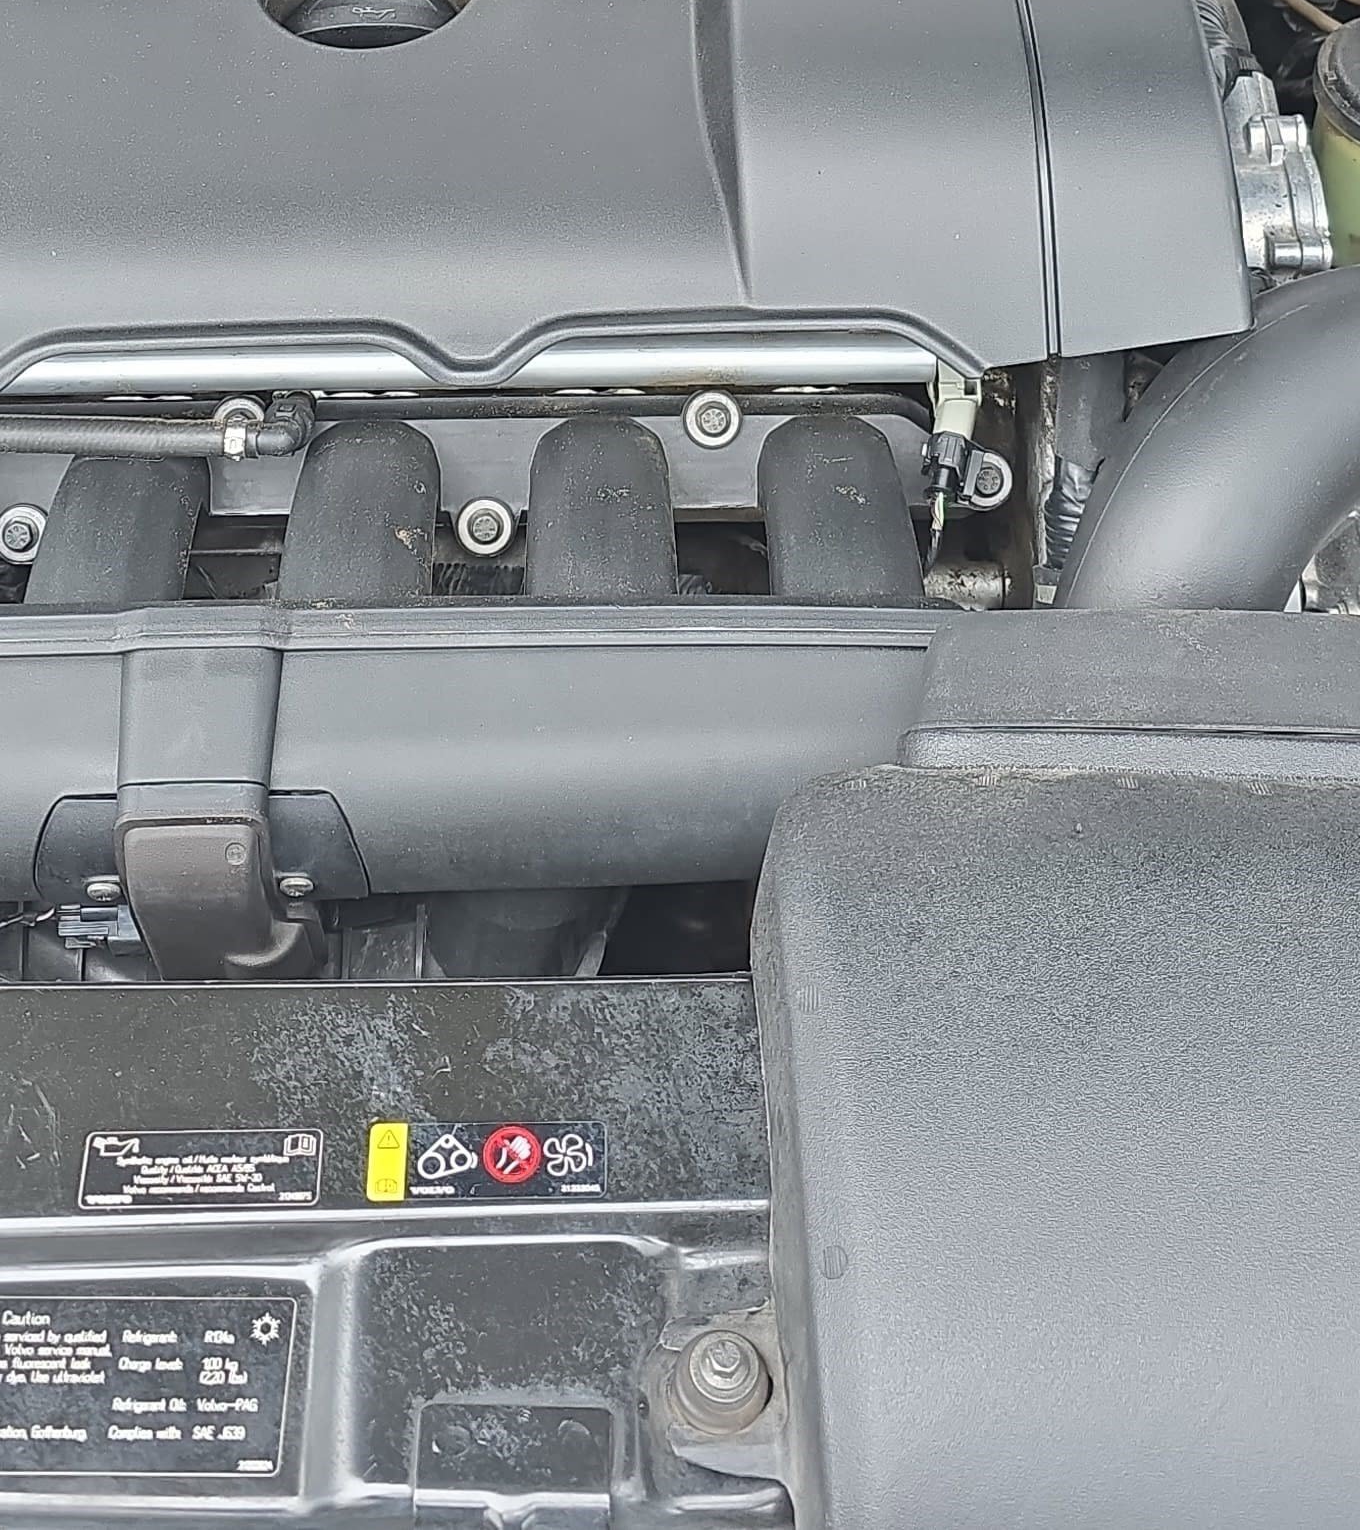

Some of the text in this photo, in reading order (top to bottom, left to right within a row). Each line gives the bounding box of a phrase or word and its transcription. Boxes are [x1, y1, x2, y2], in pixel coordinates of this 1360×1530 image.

[2, 1311, 51, 1326] Caution
[47, 1330, 61, 1343] by
[4, 1344, 34, 1356] Volvo
[37, 1345, 73, 1356] service
[118, 1357, 152, 1373] Charge
[225, 1358, 239, 1372] kg
[30, 1372, 50, 1383] Use
[111, 1398, 166, 1414] Refrigerant
[192, 1425, 215, 1440] SAE
